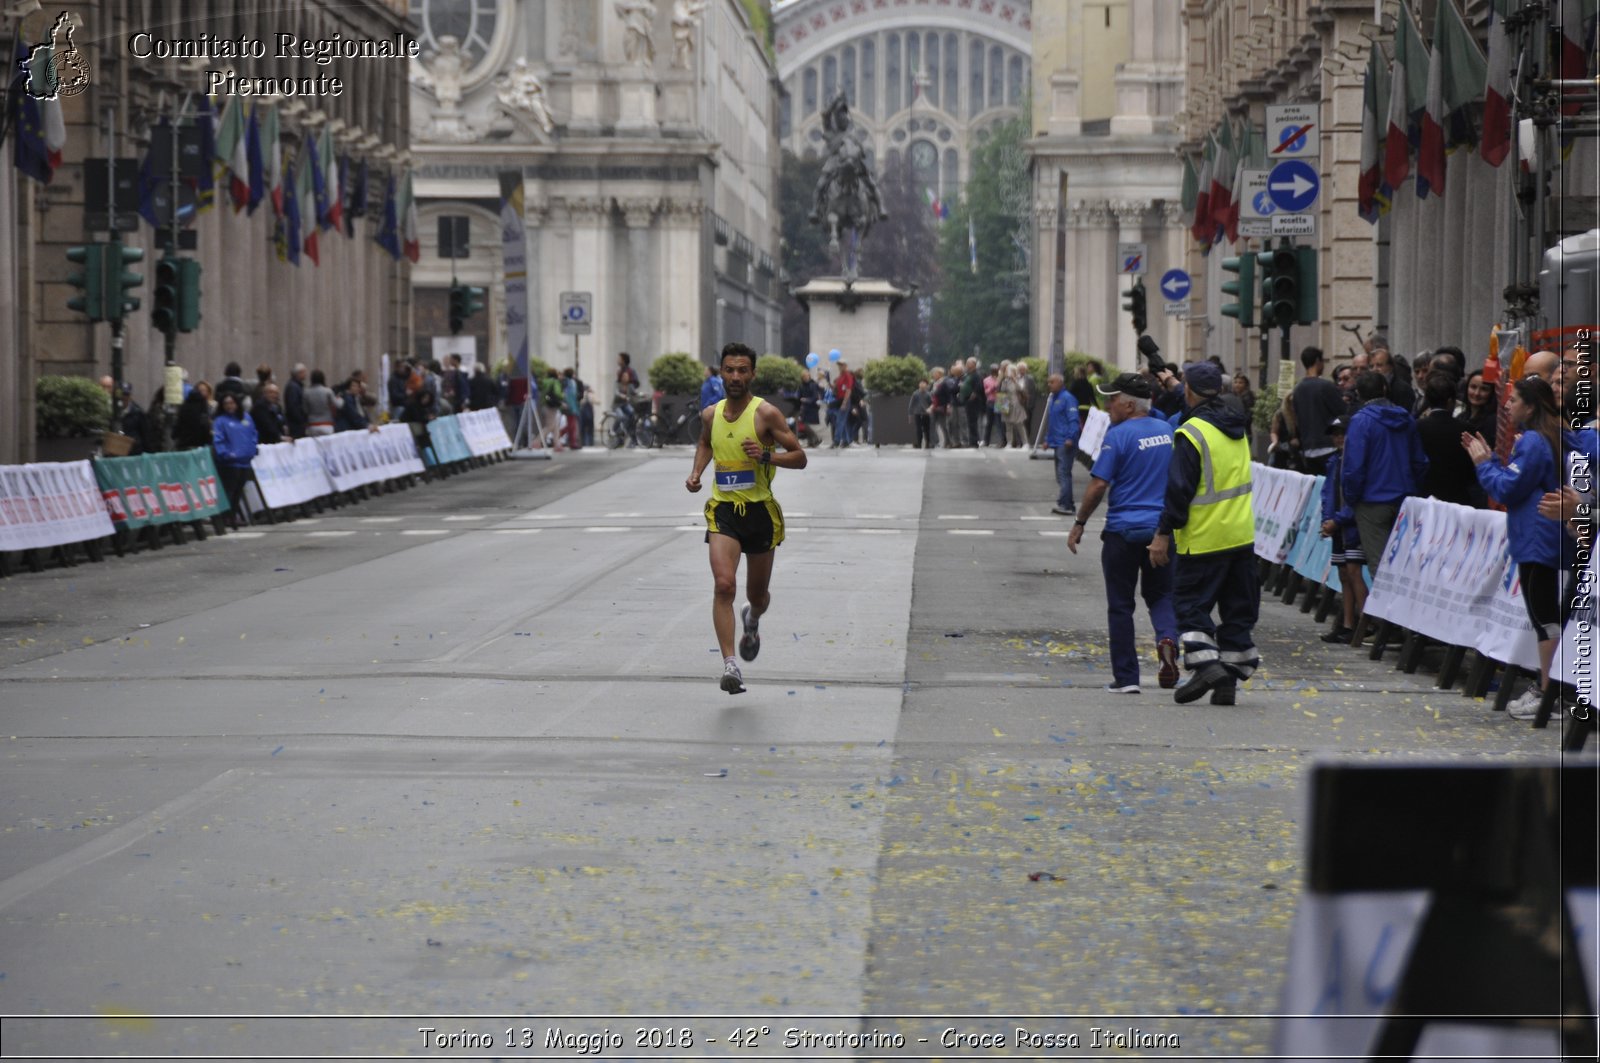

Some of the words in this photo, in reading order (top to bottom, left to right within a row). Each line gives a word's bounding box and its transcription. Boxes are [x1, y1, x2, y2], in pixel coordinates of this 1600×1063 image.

[1275, 114, 1310, 122] pedonale
[1279, 216, 1307, 224] eccetto
[1273, 225, 1313, 234] autorizzati
[726, 475, 738, 485] 17
